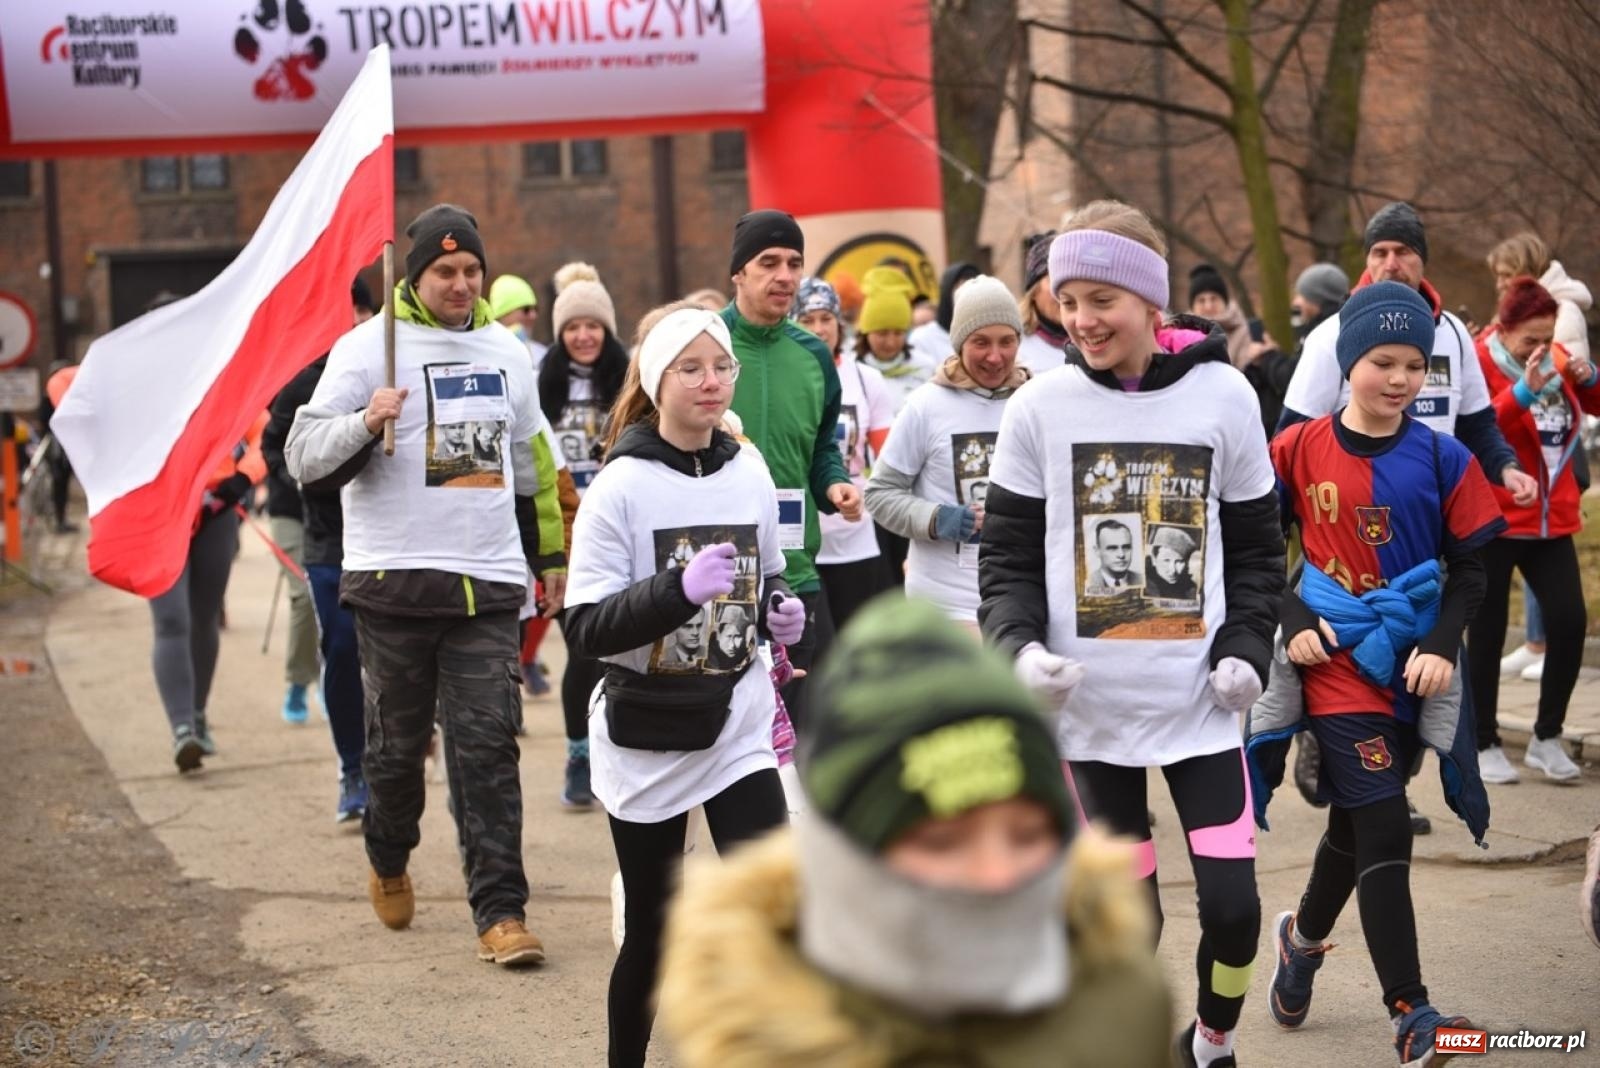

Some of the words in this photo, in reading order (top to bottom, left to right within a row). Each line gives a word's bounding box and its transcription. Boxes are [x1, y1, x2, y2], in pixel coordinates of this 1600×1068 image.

[1380, 312, 1412, 330] NY
[463, 377, 478, 391] 21
[1415, 400, 1435, 413] 103
[1126, 463, 1168, 475] TROPEM
[1126, 476, 1204, 497] WILCZYM
[1305, 481, 1338, 525] 19
